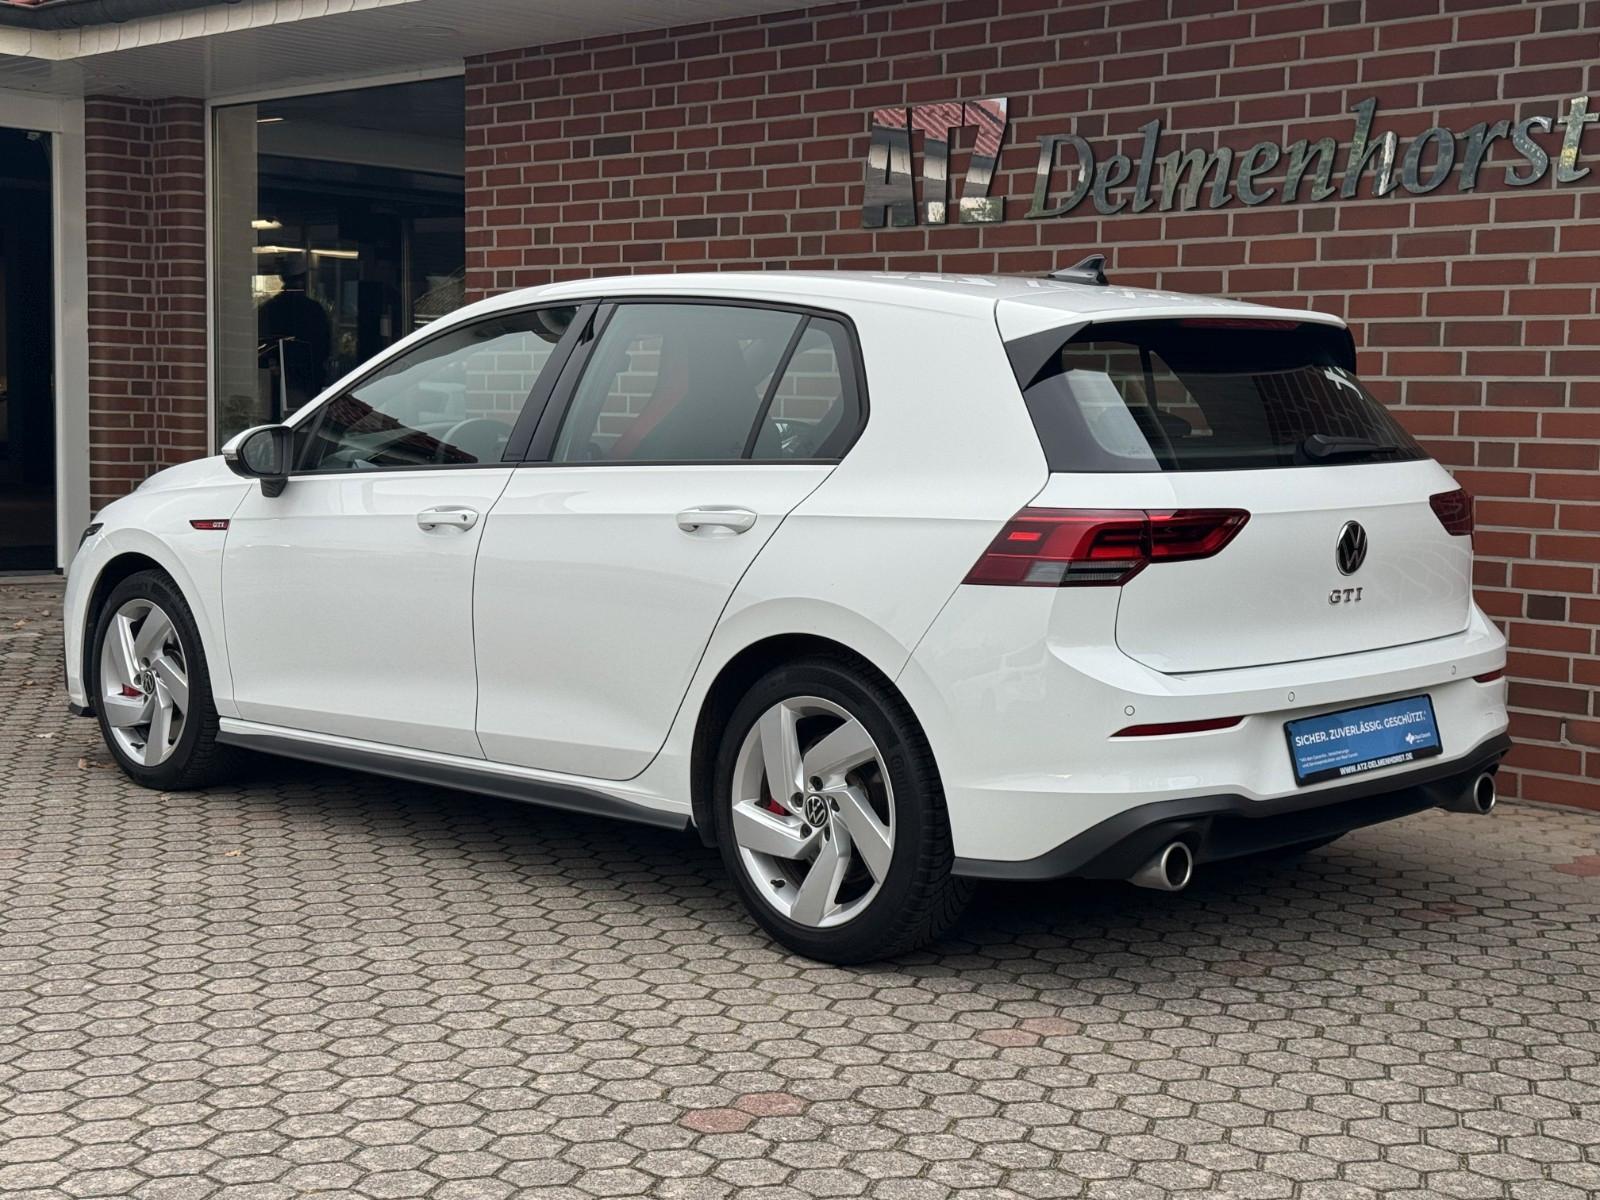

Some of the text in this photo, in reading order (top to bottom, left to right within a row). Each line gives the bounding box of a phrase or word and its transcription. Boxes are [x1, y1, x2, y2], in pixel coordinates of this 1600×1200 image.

[863, 96, 1599, 228] ATZ Delmenhorst
[1328, 587, 1363, 605] GTI
[1295, 731, 1329, 747] SICHER.
[1329, 721, 1384, 740] ZUVERLÄSSIG.
